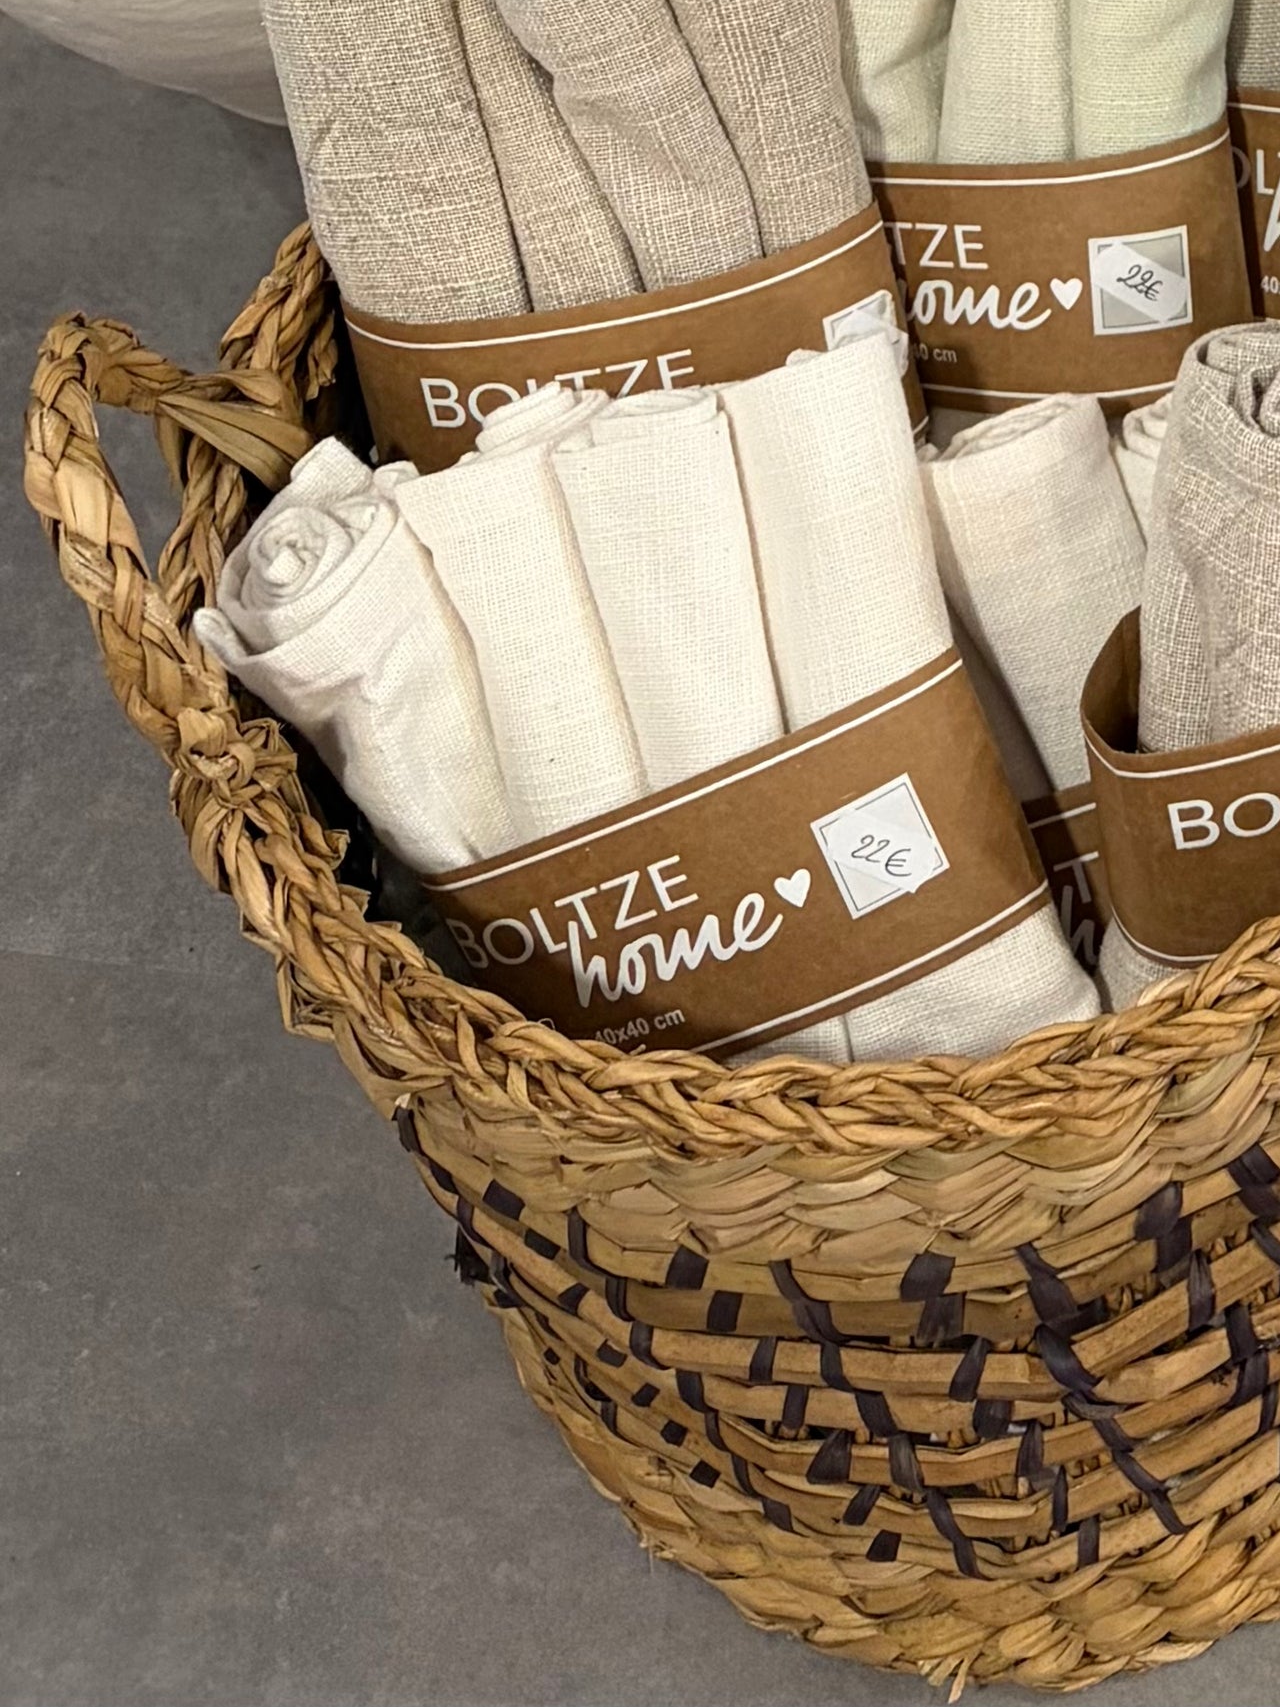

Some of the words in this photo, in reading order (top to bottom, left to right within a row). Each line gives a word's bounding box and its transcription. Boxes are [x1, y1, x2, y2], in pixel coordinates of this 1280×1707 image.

[445, 854, 700, 969] BOLTZE
[567, 892, 784, 1008] home
[653, 1009, 686, 1030] cm
